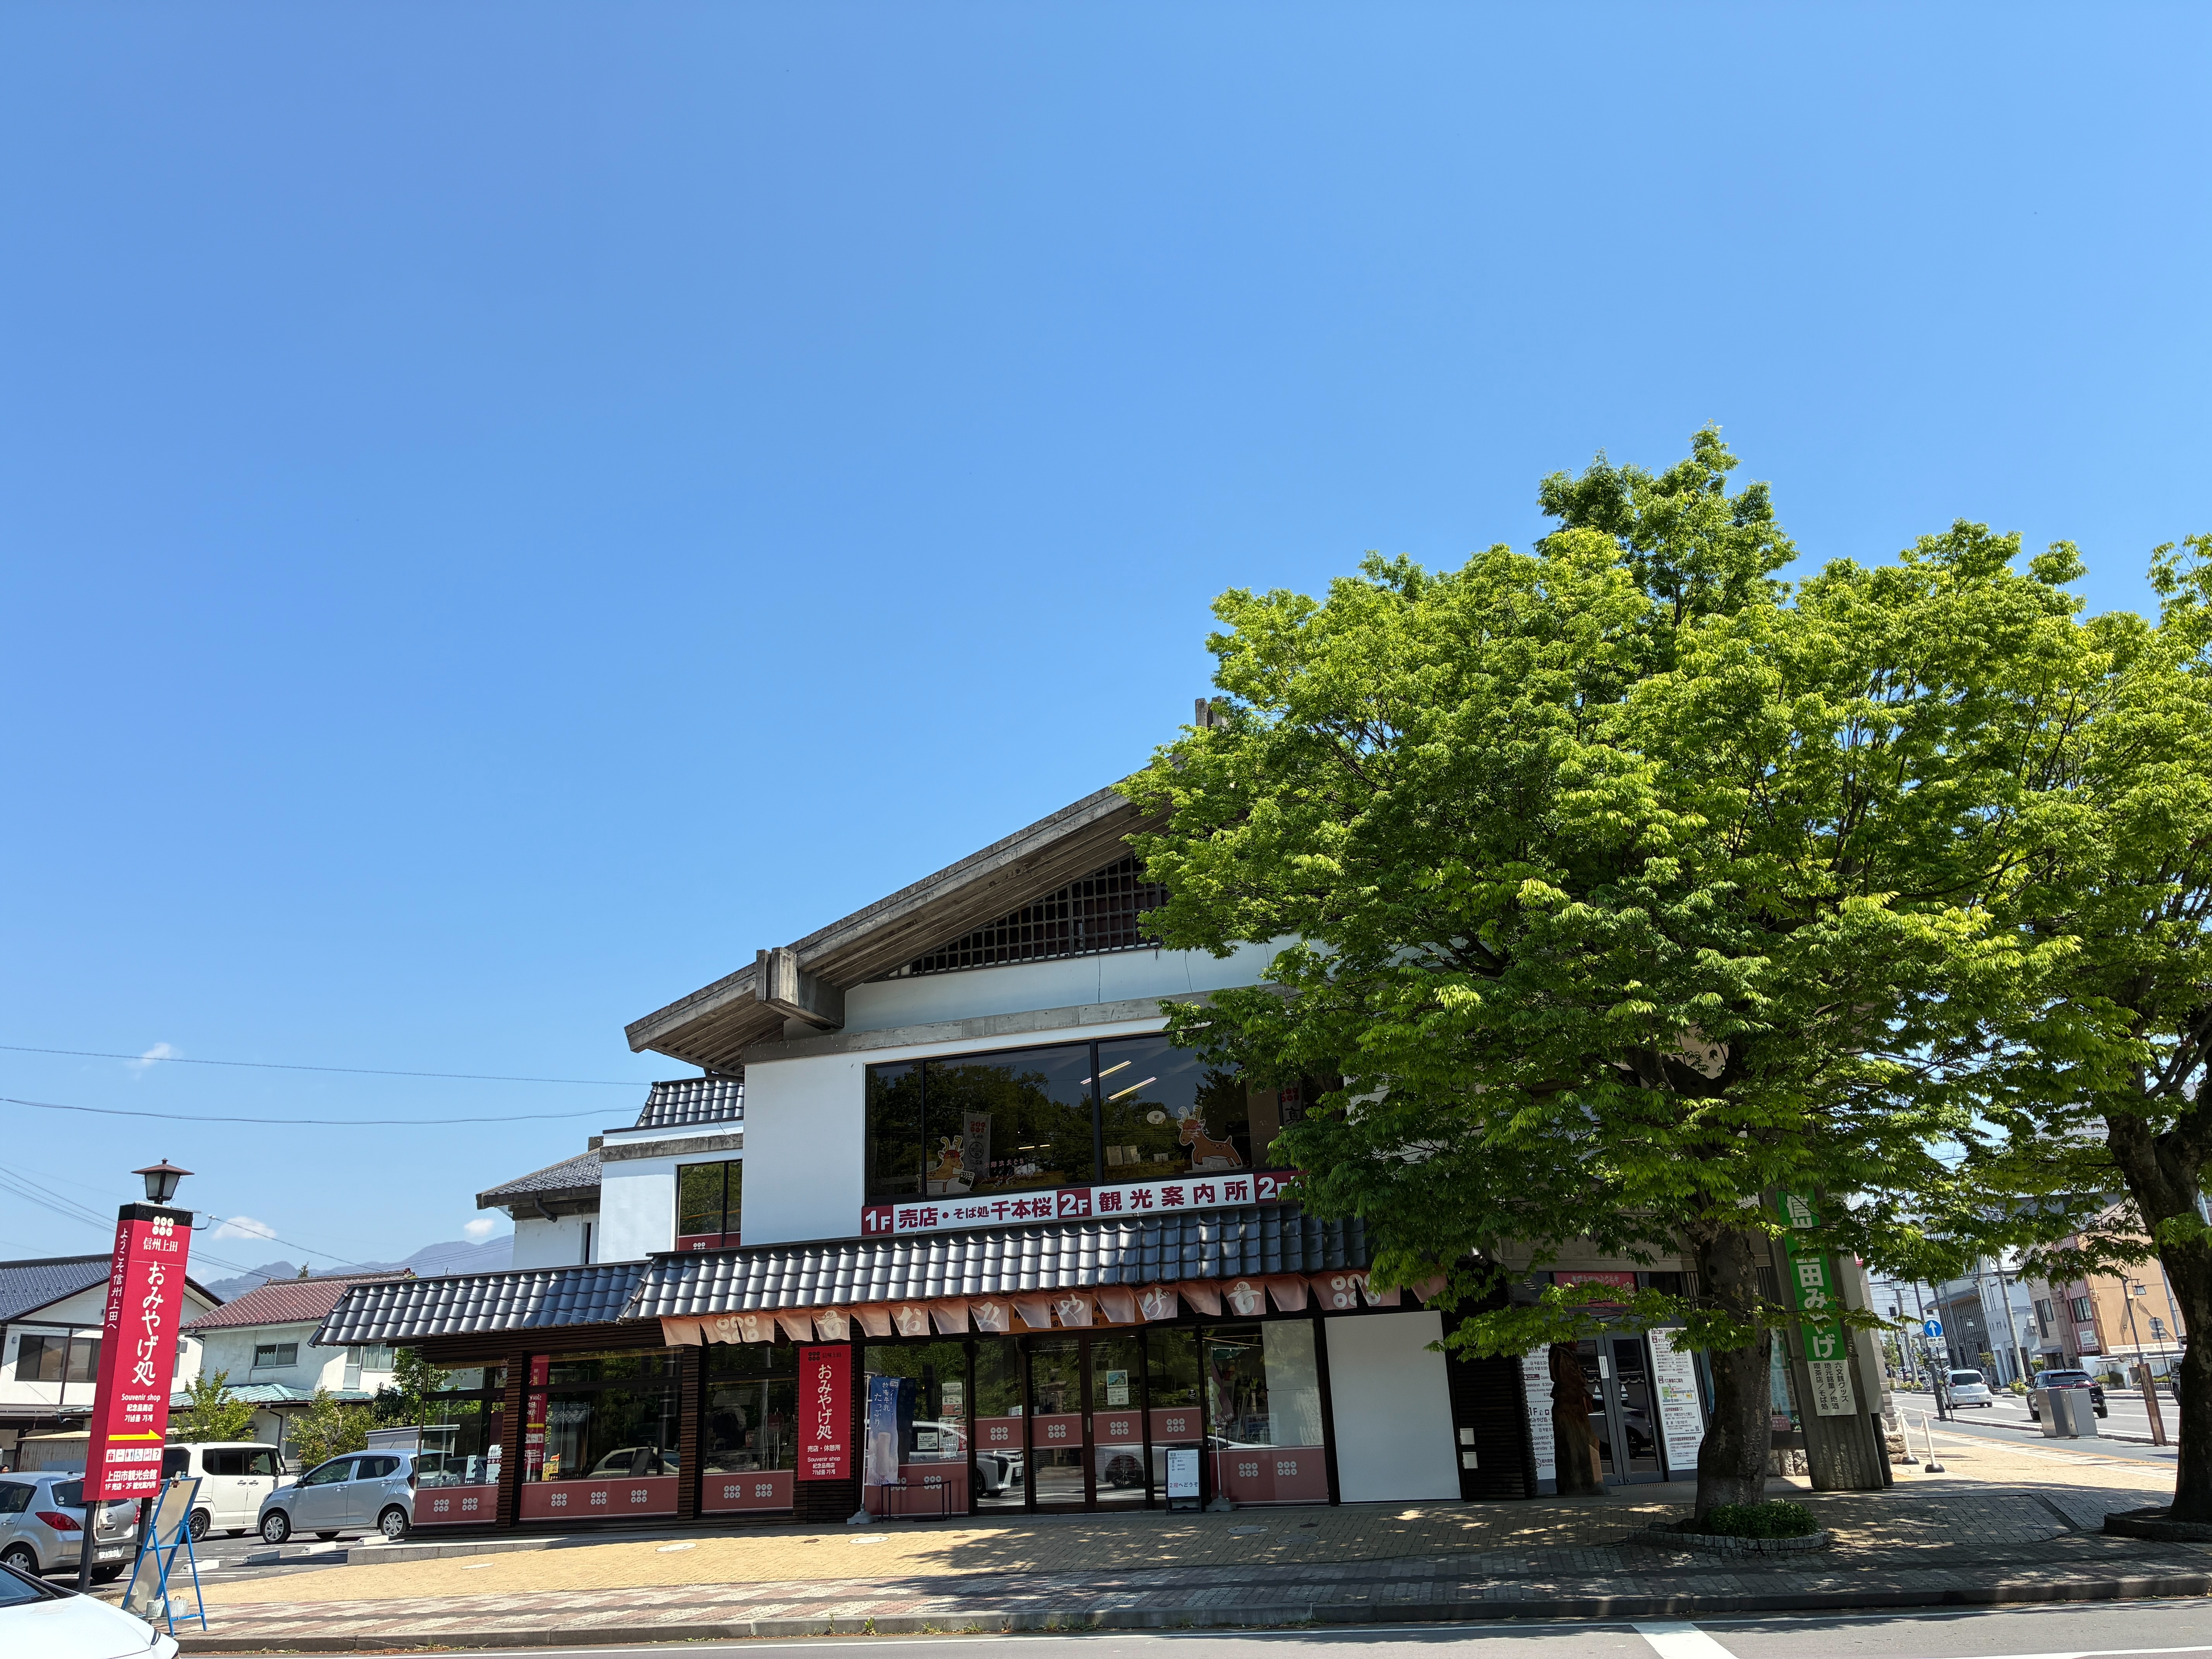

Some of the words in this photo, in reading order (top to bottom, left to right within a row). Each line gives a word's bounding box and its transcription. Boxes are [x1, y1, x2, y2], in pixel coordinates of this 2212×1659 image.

[865, 1210, 891, 1231] 1F
[1060, 1194, 1088, 1216] 2F
[1099, 1180, 1248, 1212] 観光案内所
[143, 1237, 178, 1252] 信州上田
[107, 1228, 128, 1329] ようこそ信州上田へ
[1787, 1195, 1836, 1358] 信田みげ
[132, 1261, 165, 1386] おみやげ処
[147, 1393, 160, 1402] shop
[816, 1364, 833, 1440] おみやげ処
[1835, 1362, 1849, 1402] 六文銭グッズ
[105, 1469, 157, 1482] 上田市観光会館
